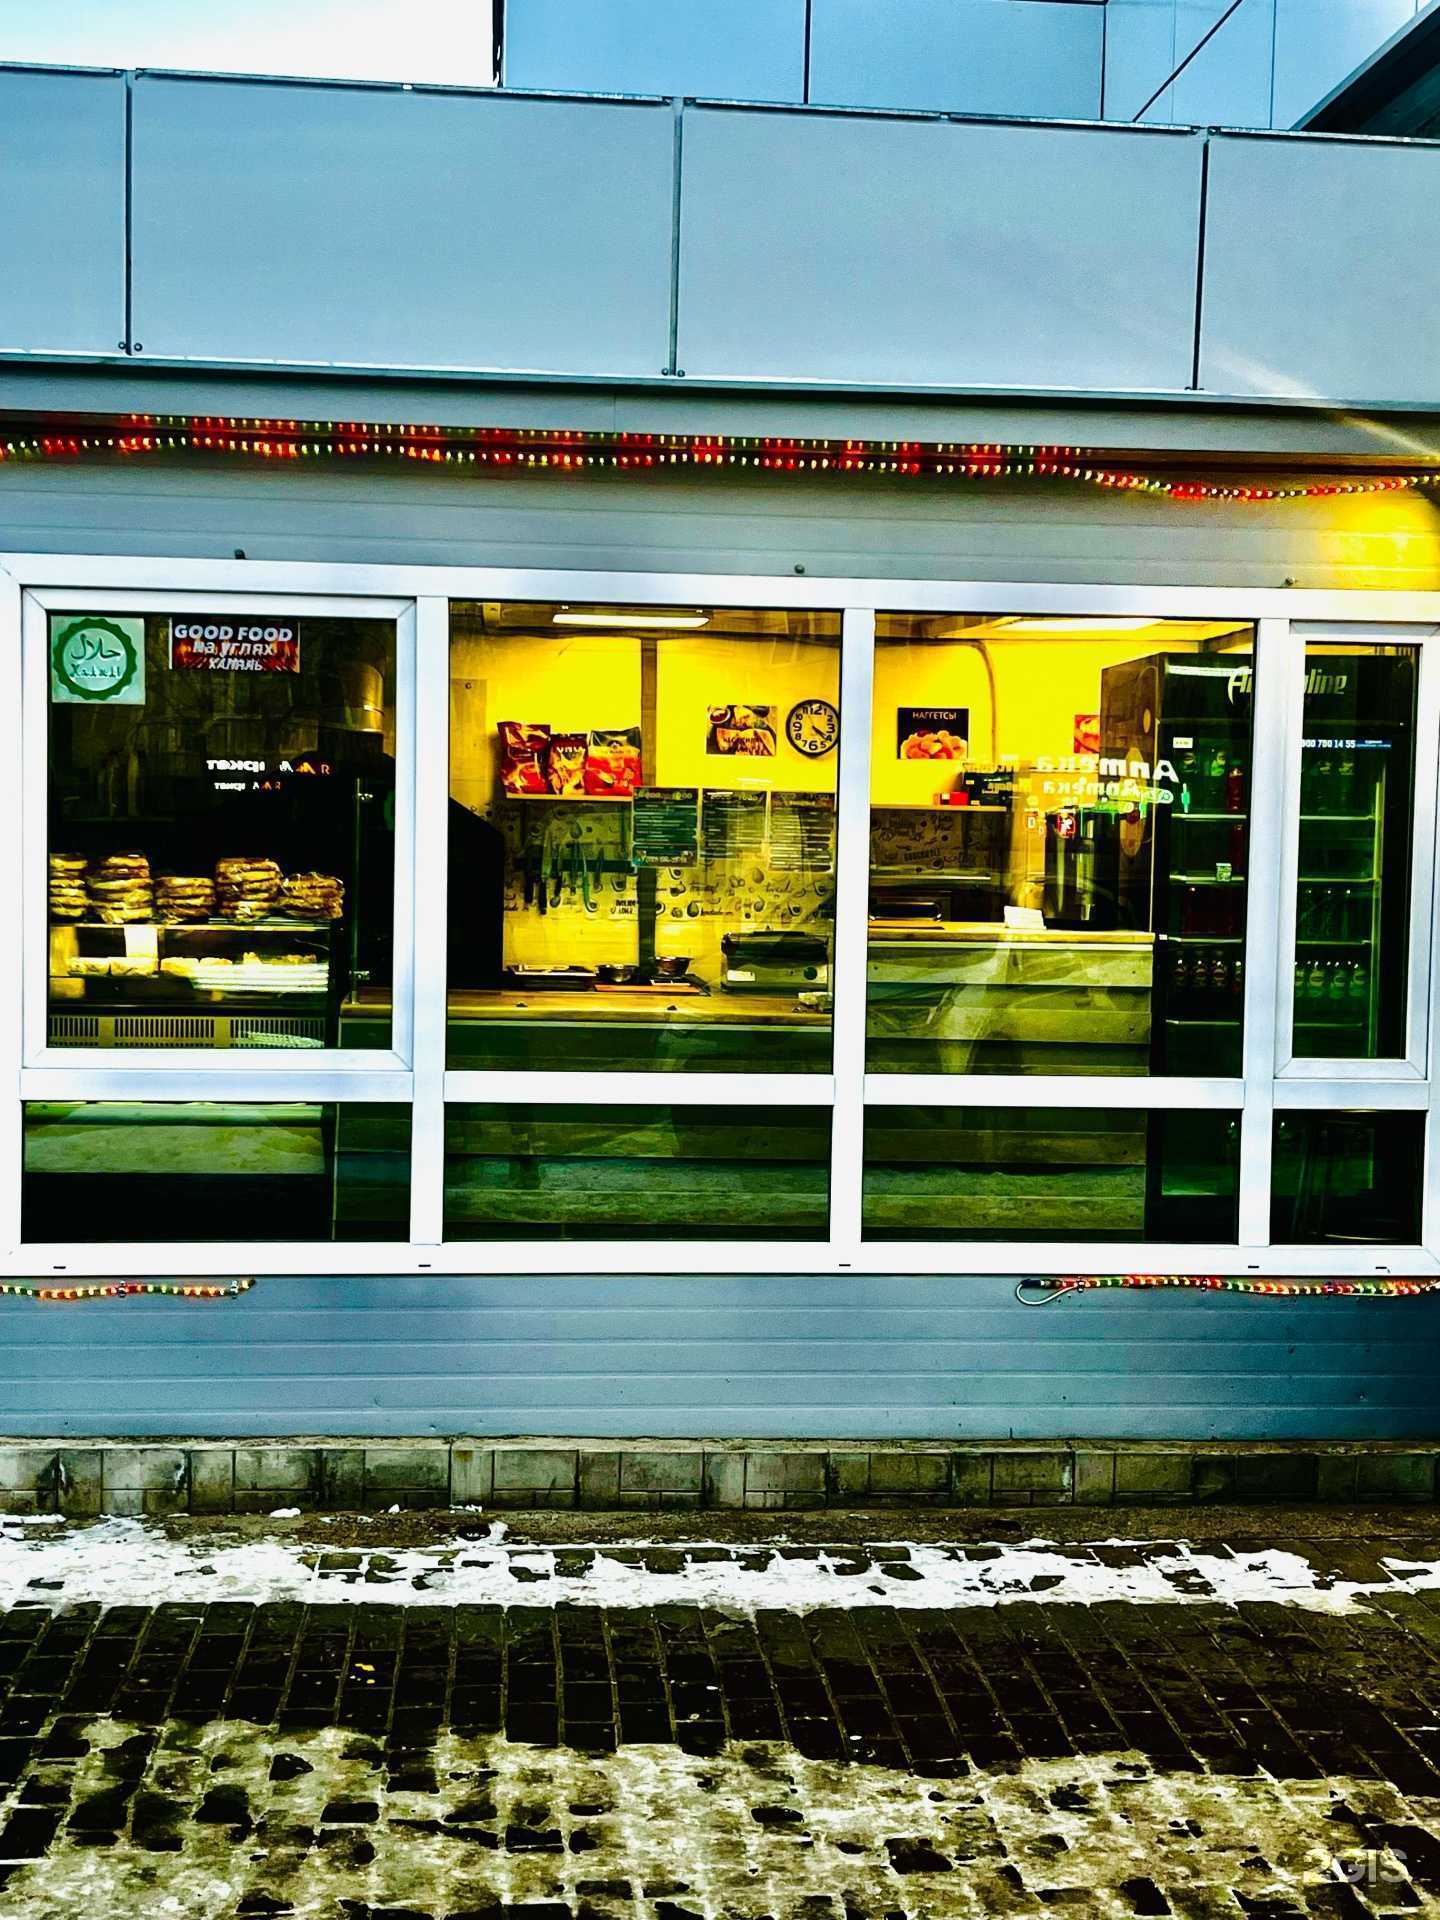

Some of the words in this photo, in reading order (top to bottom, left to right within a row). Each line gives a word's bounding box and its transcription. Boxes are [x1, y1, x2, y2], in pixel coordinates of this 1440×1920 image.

[174, 624, 234, 641] GOOD
[237, 626, 293, 642] FOOD
[70, 632, 121, 661] حلال
[911, 710, 958, 721] НАГГЕТСЫ
